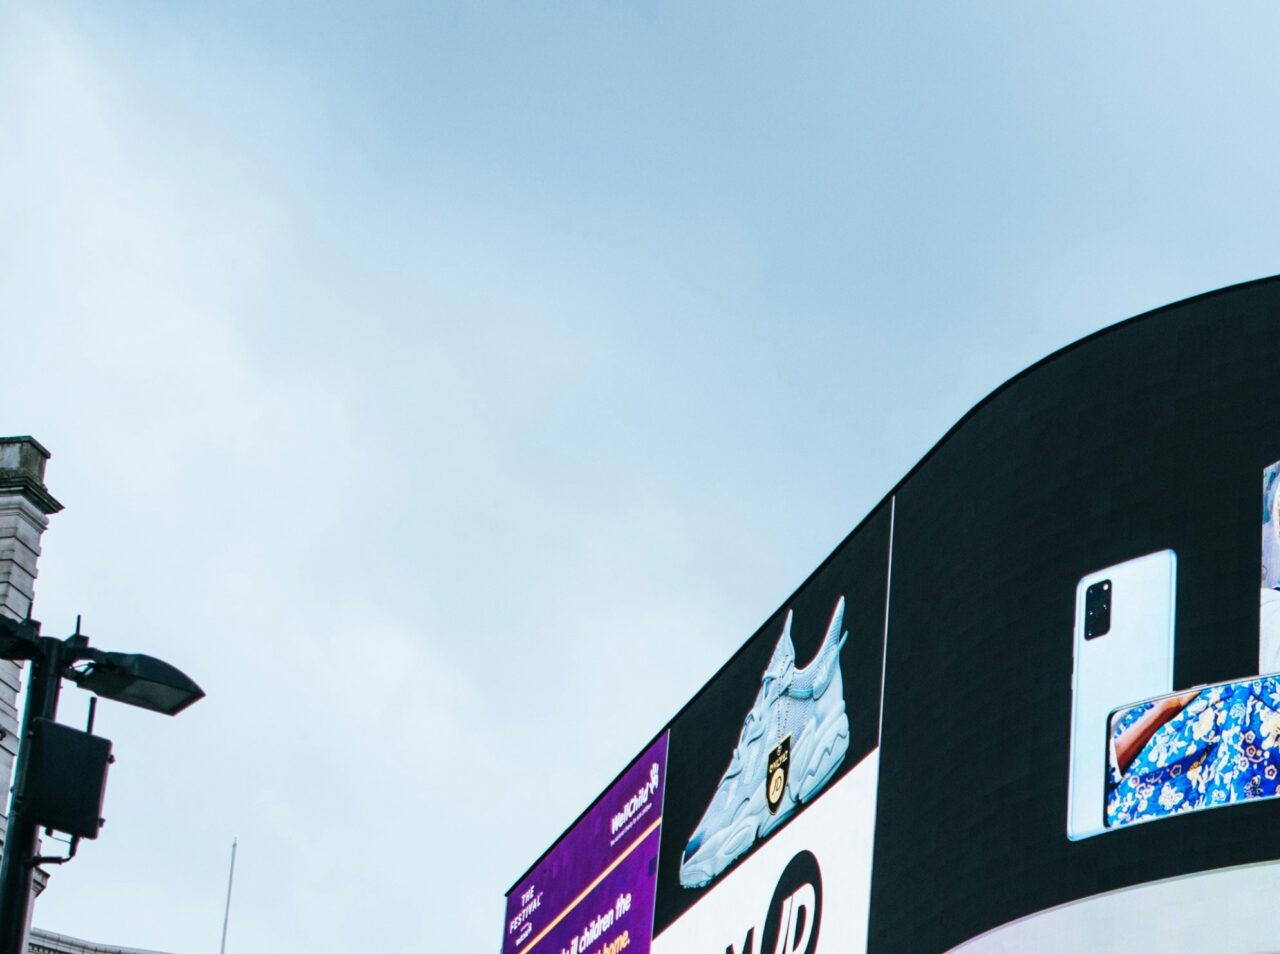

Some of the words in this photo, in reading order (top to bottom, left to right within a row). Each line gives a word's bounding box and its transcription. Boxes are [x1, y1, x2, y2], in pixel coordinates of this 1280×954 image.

[611, 782, 650, 835] WellChild
[521, 885, 535, 907] THE
[579, 909, 614, 953] children
[616, 893, 632, 921] the
